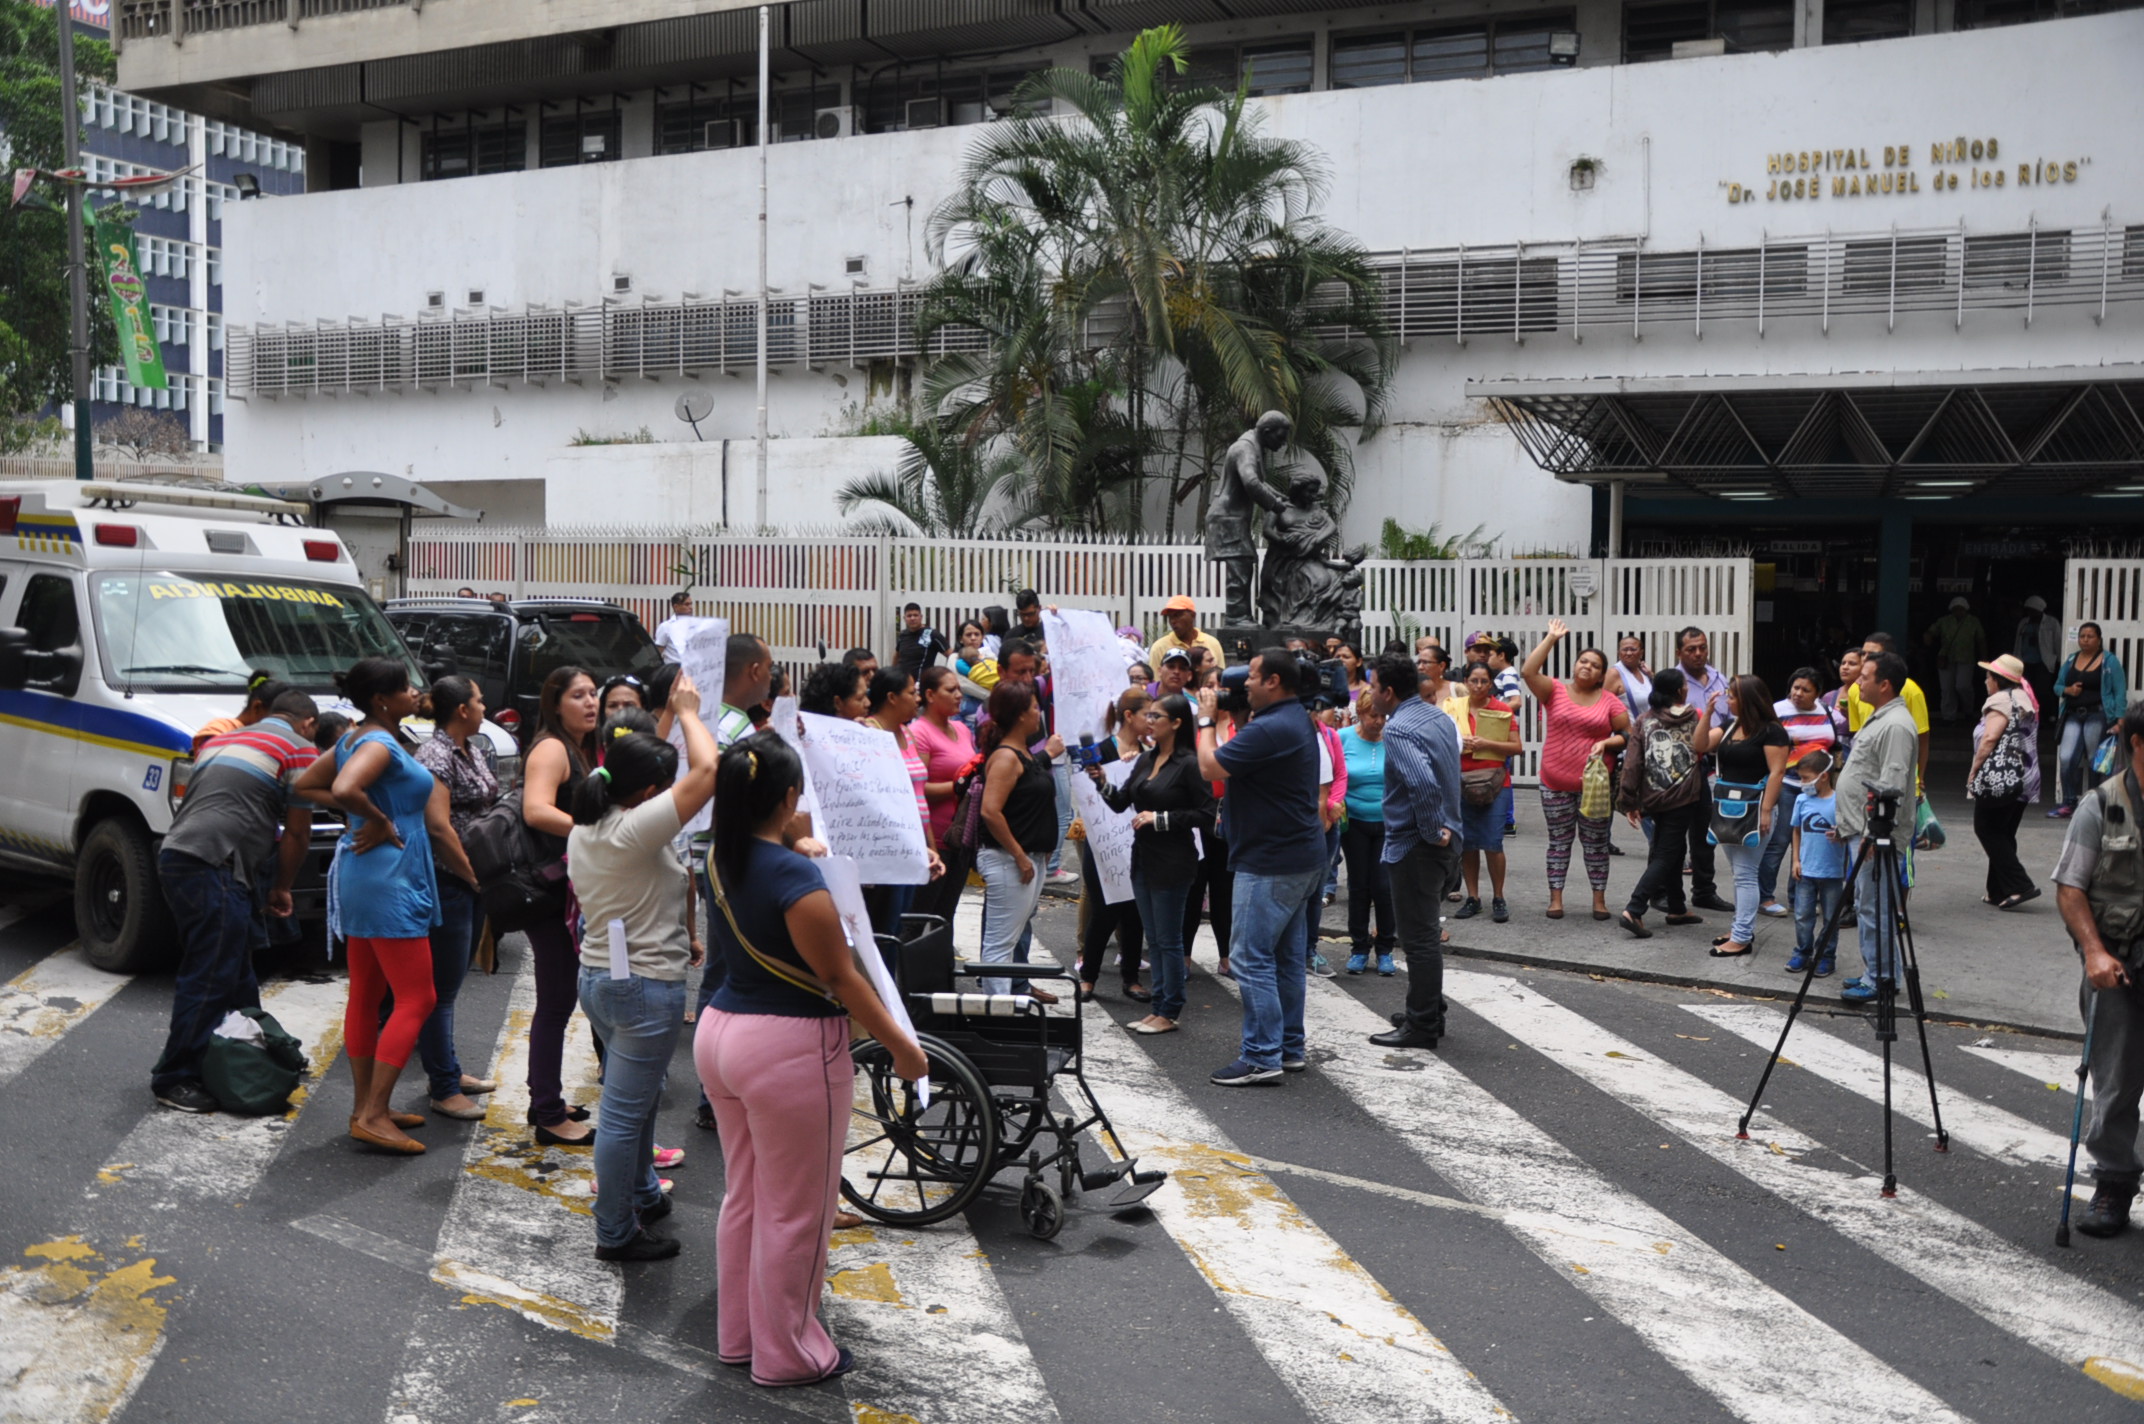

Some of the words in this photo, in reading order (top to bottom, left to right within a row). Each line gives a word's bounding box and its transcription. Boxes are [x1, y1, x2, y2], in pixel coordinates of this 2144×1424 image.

[1767, 147, 1870, 173] HOSPITAL
[1884, 145, 1910, 167] DE
[1931, 136, 1999, 163] NIÑOS
[1767, 173, 1820, 201] JOSÉ
[1832, 170, 1920, 197] MANUEL
[1933, 169, 1958, 191] de
[1771, 542, 1818, 552] SALIDA
[1964, 543, 2027, 554] ENTRADA
